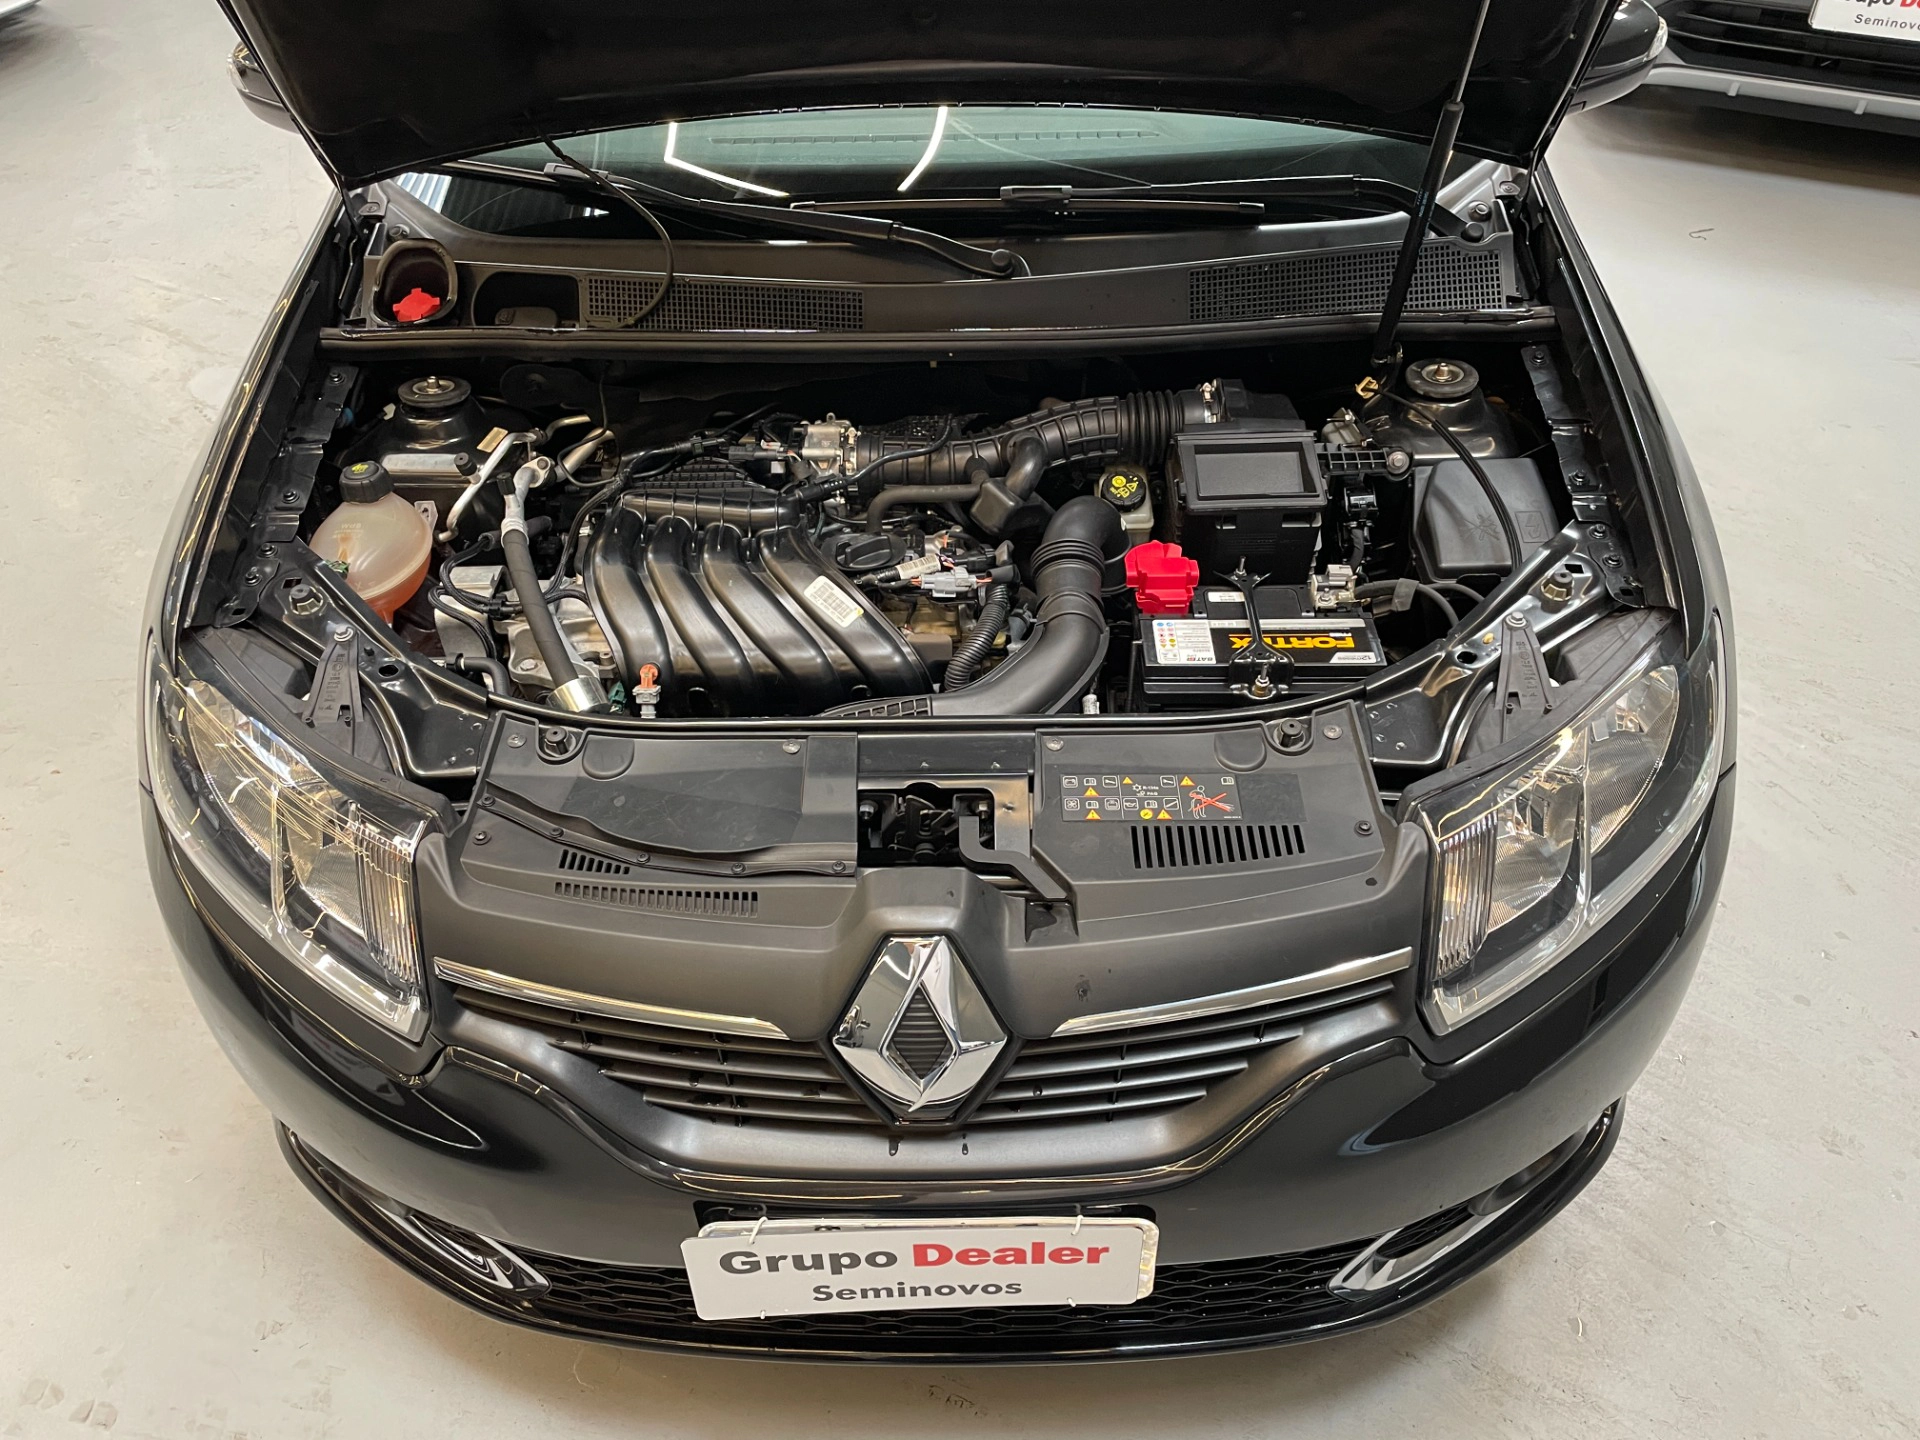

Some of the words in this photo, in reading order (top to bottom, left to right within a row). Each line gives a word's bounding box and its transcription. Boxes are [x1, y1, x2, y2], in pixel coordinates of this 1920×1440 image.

[1900, 0, 1920, 8] D
[719, 1251, 898, 1275] Grupo
[913, 1242, 1110, 1267] Dealer
[813, 1282, 1022, 1301] Seminovos
